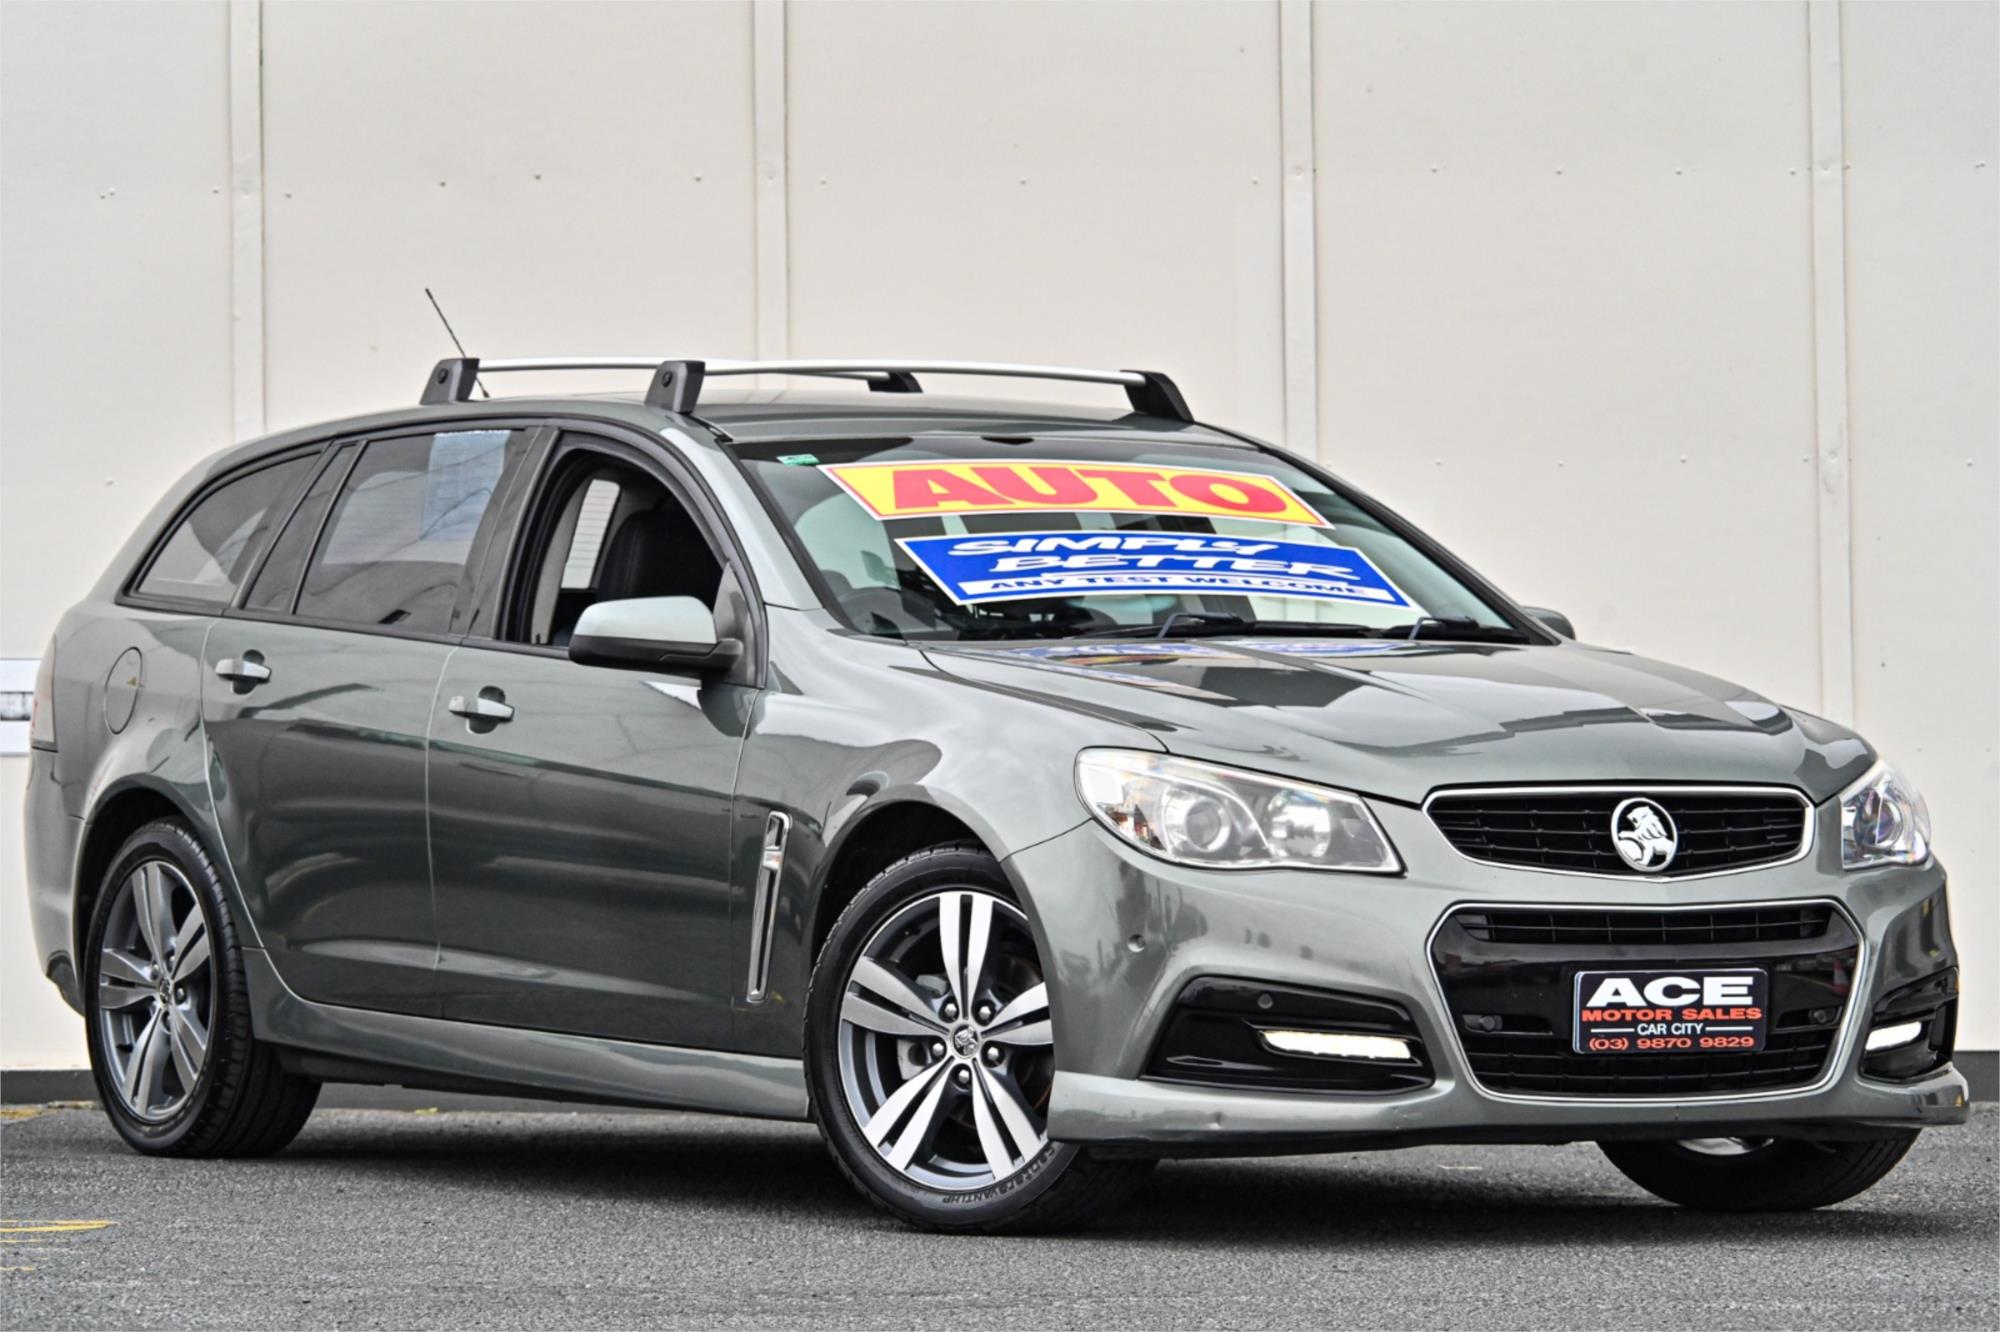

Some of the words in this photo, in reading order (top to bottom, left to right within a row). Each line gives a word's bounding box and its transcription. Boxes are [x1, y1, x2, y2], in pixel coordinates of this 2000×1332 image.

[893, 467, 1287, 513] AUTO
[948, 537, 1279, 556] SIMPLY
[988, 554, 1361, 580] BETTER
[991, 578, 1065, 589] ANY
[1078, 576, 1174, 584] TEST
[1184, 576, 1368, 595] WELCOME
[1585, 976, 1754, 1007] ACE
[1582, 1009, 1672, 1022] MOTOR
[1682, 1008, 1762, 1020] SALES
[1637, 1023, 1667, 1035] CAR
[1671, 1022, 1704, 1035] CITY
[1589, 1037, 1629, 1050] (03)
[1636, 1037, 1691, 1049] 9870
[1699, 1036, 1754, 1048] 9829
